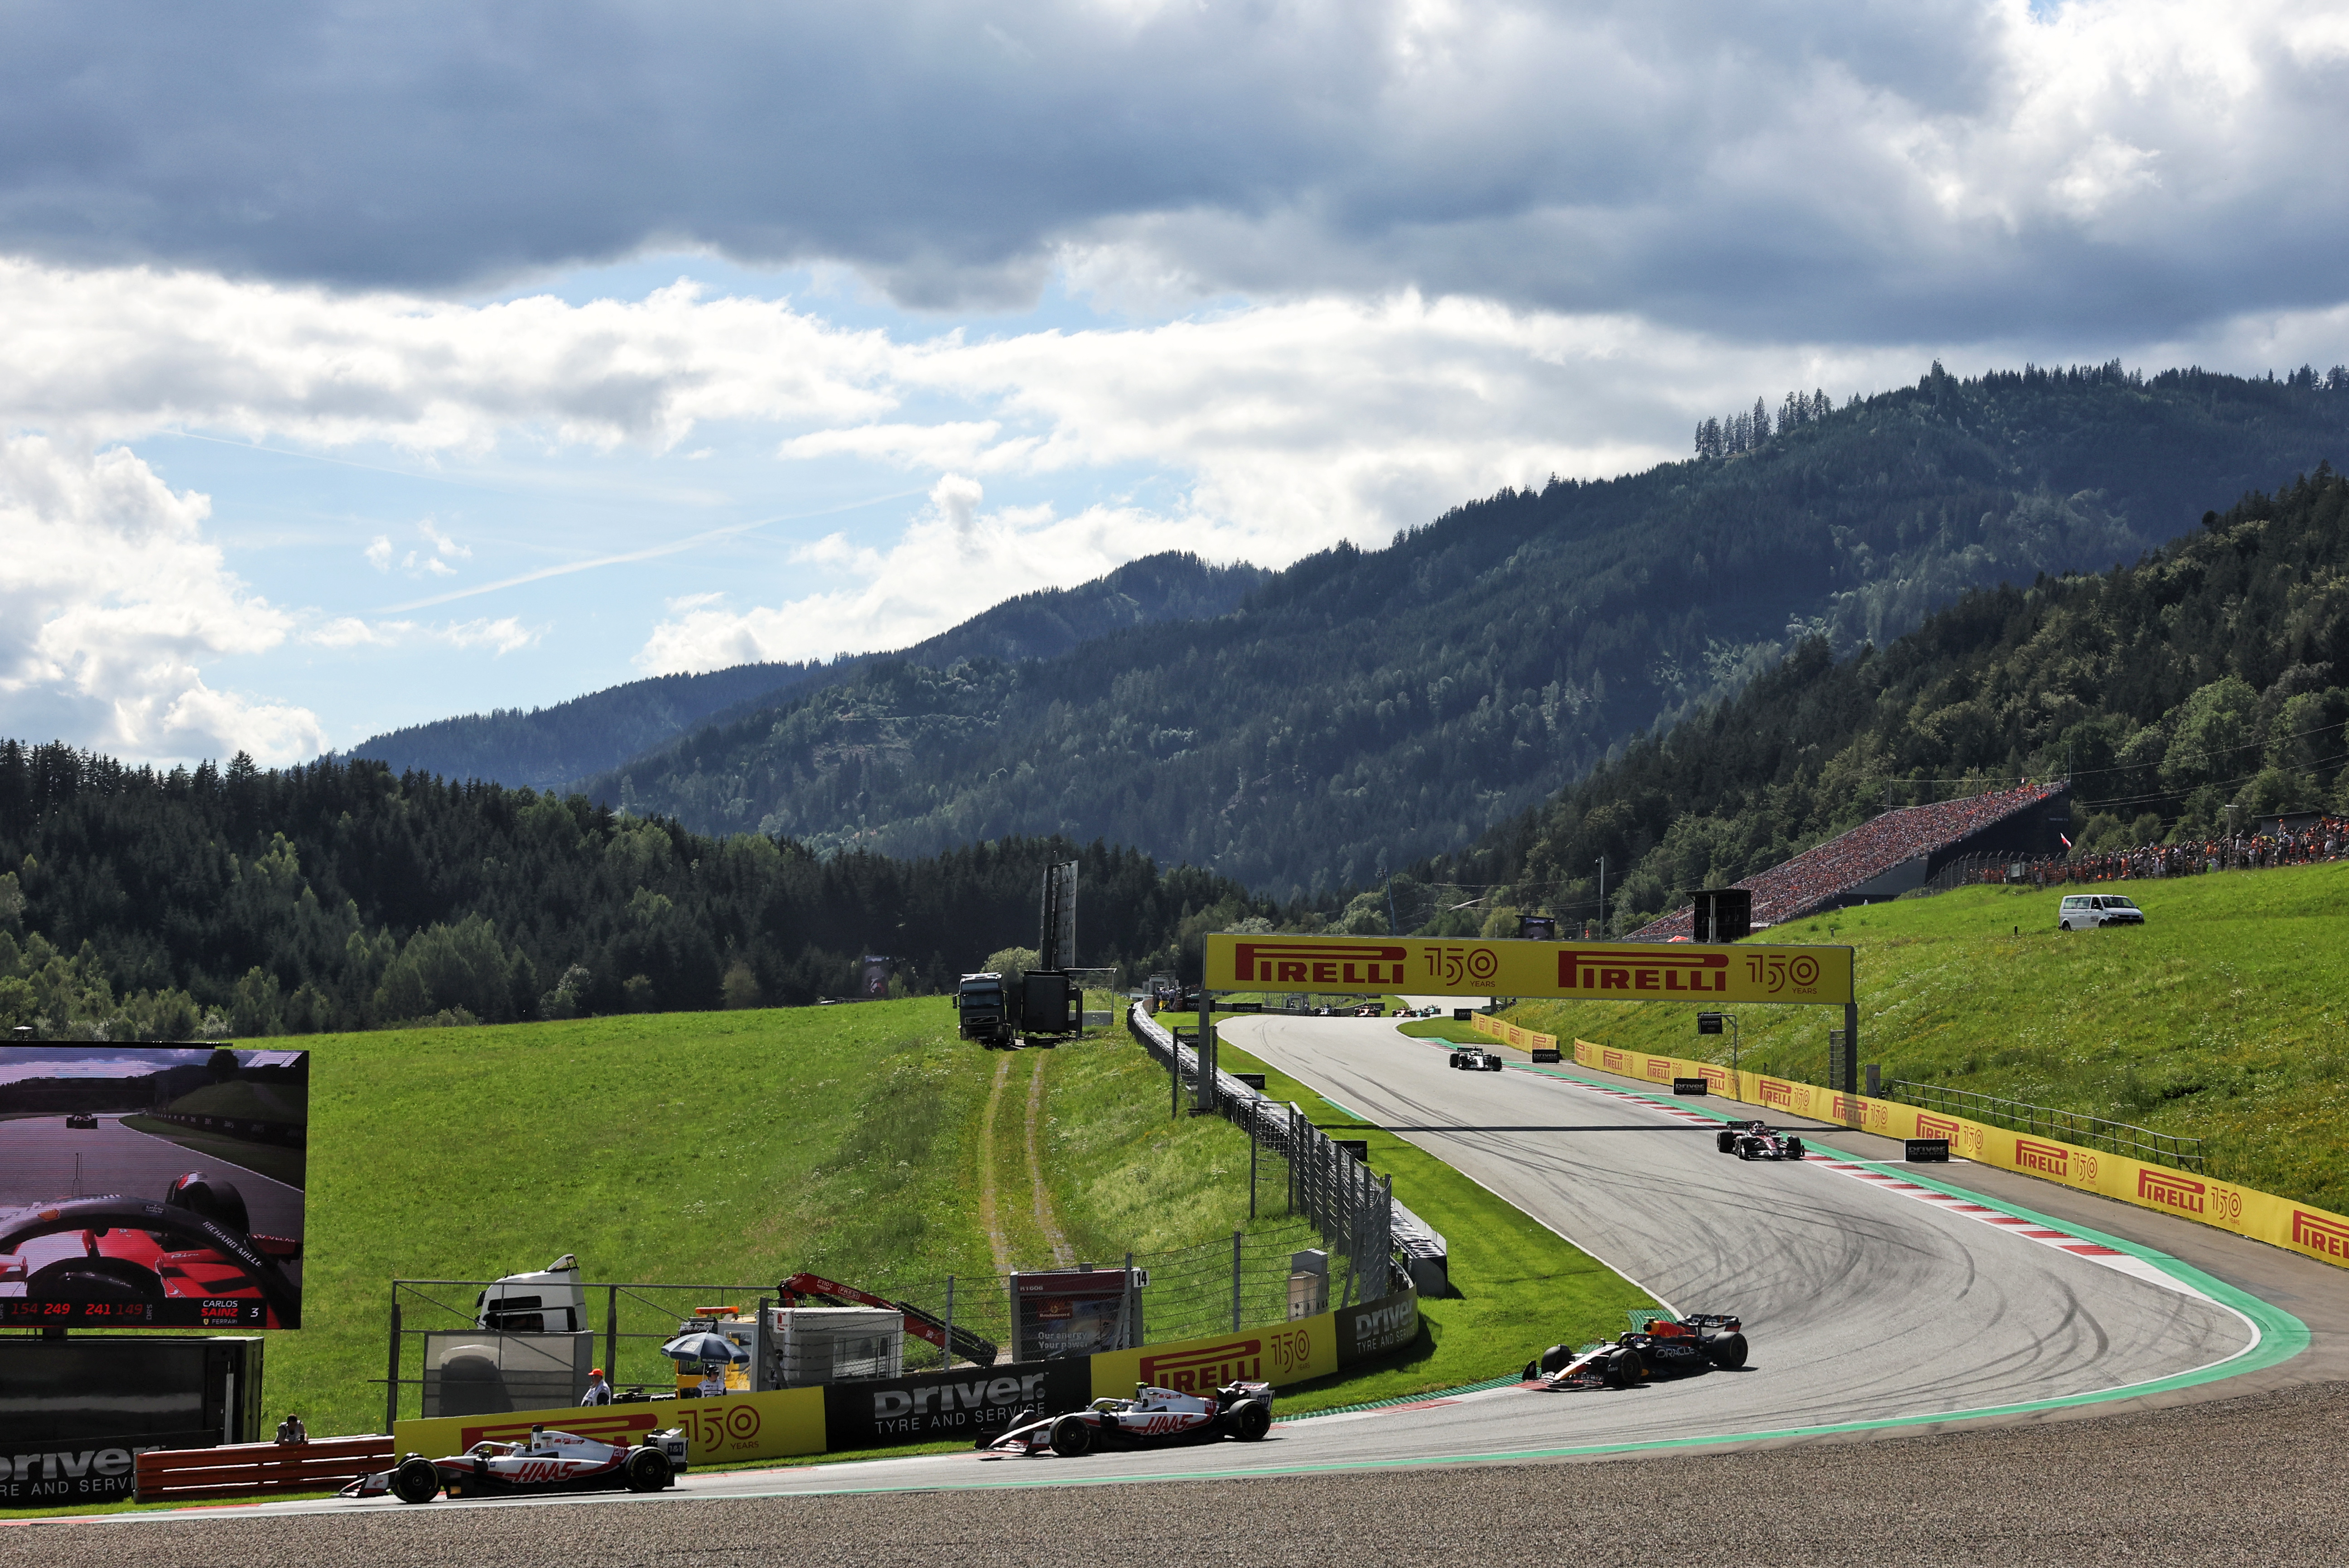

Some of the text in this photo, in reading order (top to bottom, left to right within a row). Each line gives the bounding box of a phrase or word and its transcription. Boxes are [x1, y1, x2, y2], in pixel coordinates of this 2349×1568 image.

[1235, 943, 1497, 986] PIRELLI 150
[1558, 950, 1819, 993] PIRELLI 150
[1603, 1050, 1623, 1070] PIRELLI
[1647, 1059, 1670, 1080] PIRELLI
[1727, 1073, 1740, 1093] 150
[1760, 1080, 1810, 1110] PIRELLI 150
[1833, 1096, 1888, 1128] PIRELLI 150
[1964, 1125, 1983, 1152] 150
[2016, 1139, 2098, 1181] PIRELLI 150
[2138, 1168, 2242, 1220] PIRELLI 150
[203, 1221, 263, 1267] RICHARD MILLE
[1136, 1271, 1147, 1286] 14
[840, 1288, 858, 1298] FASSI
[11, 1303, 38, 1314] 154
[44, 1303, 70, 1314] 249
[85, 1304, 111, 1314] 241
[116, 1304, 143, 1314] 149
[201, 1308, 238, 1317] SAINZ
[251, 1308, 259, 1317] 3
[1061, 1341, 1088, 1350] power
[1357, 1339, 1377, 1353] TYRE
[1380, 1333, 1394, 1347] AND
[1656, 1346, 1695, 1358] ORACLE
[1140, 1329, 1310, 1392] PIRELLI 150
[1297, 1362, 1310, 1370] YEARS
[678, 1405, 760, 1452] 150
[875, 1418, 920, 1434] TYRE
[931, 1413, 965, 1428] AND
[1140, 1414, 1194, 1435] HAAS
[613, 1448, 625, 1457] 20
[730, 1441, 759, 1449] YEARS
[512, 1462, 581, 1483] HAAS
[31, 1481, 68, 1495] AND
